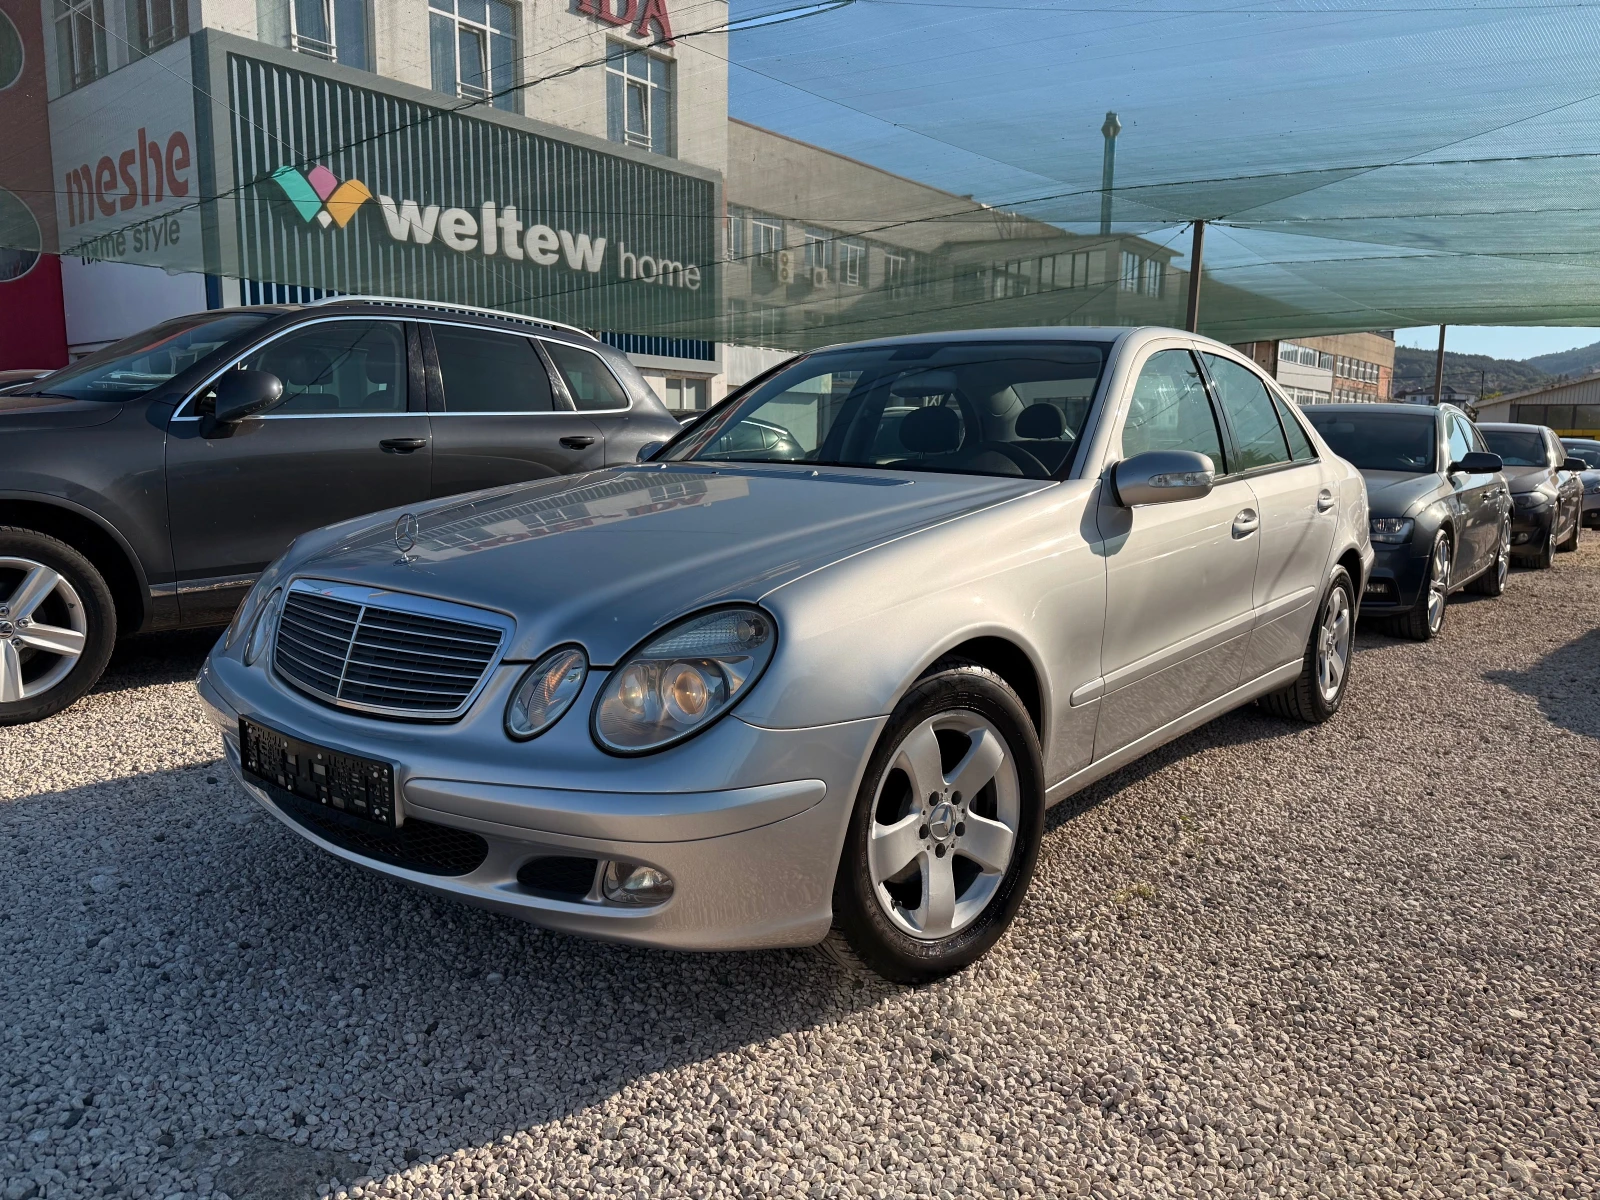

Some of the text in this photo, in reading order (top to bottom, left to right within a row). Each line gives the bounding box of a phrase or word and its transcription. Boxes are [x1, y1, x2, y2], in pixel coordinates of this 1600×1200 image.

[577, 0, 676, 48] DA
[65, 126, 191, 228] meshe
[80, 214, 181, 266] hme style
[378, 194, 701, 291] weltew home
